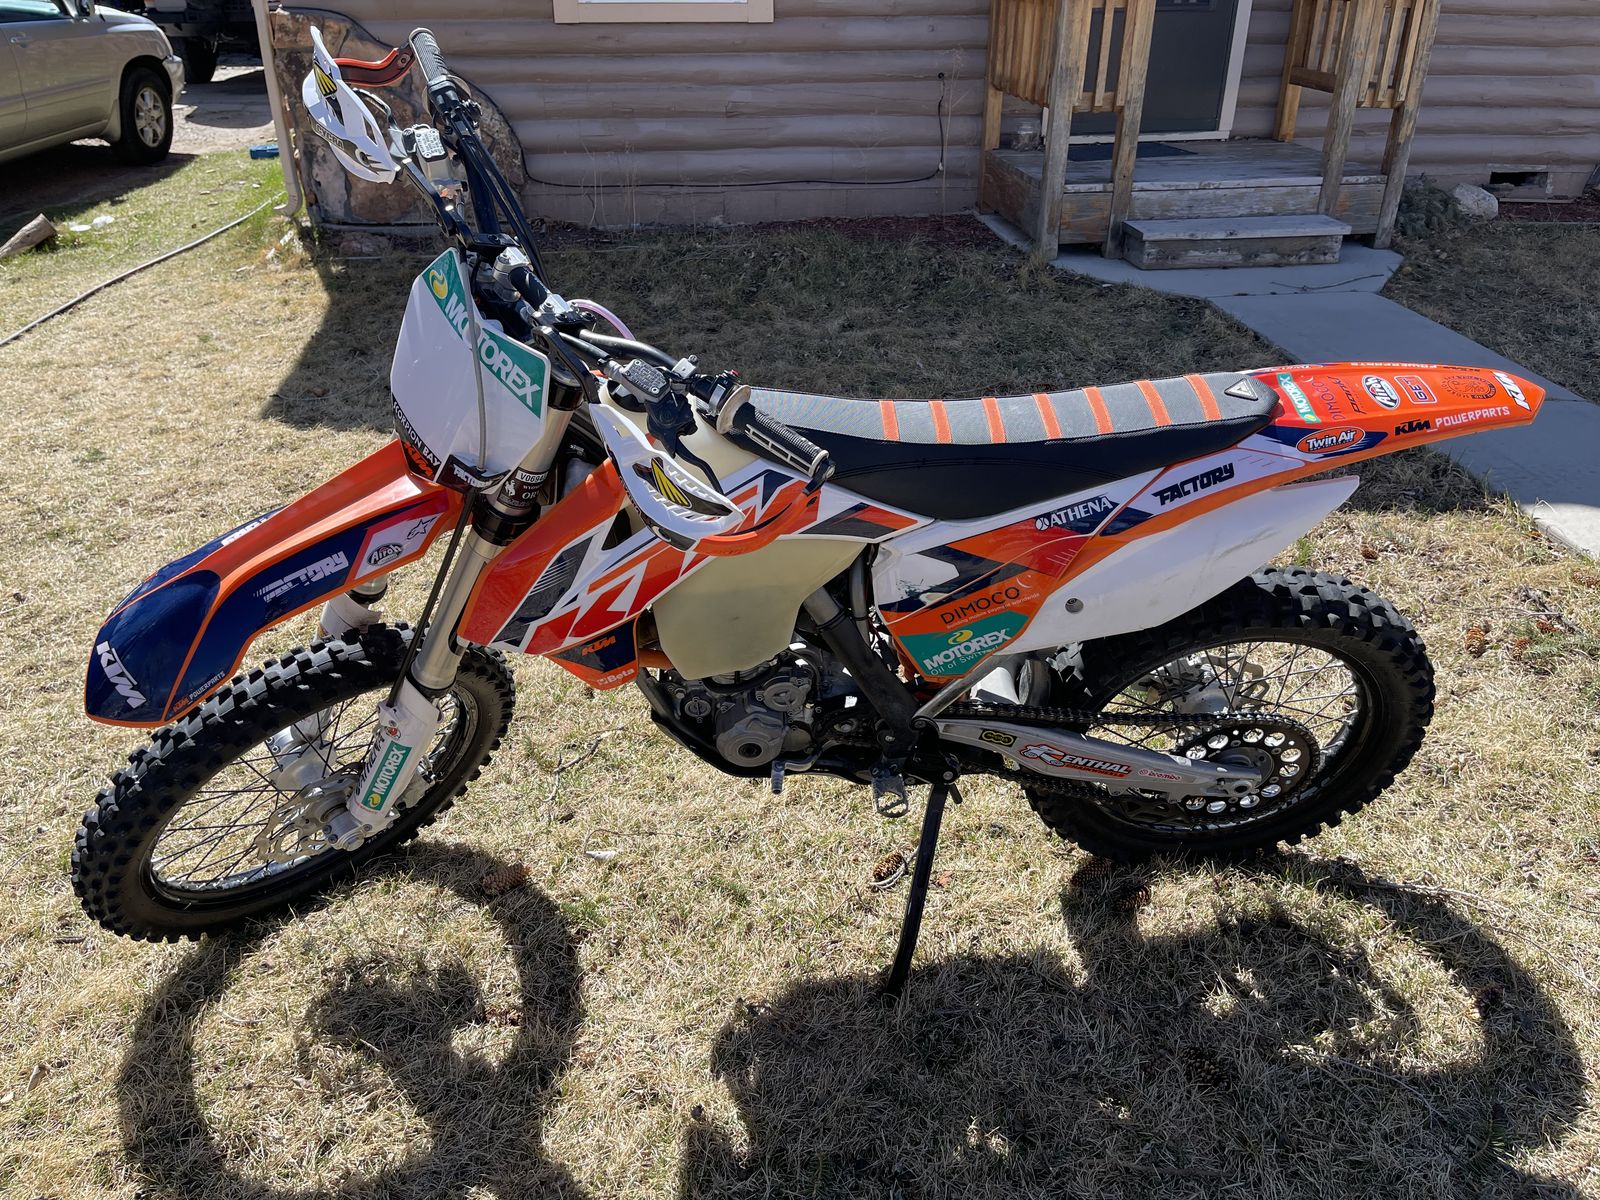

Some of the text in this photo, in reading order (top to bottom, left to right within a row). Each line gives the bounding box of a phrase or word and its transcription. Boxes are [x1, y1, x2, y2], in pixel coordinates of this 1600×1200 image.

[445, 293, 541, 408] MOTOREX
[1280, 376, 1312, 413] MOTOREX
[1311, 381, 1346, 420] DIMOCO
[1367, 377, 1396, 408] Airoh
[393, 401, 441, 466] SCORPION BAY
[1307, 435, 1337, 450] Twin
[1338, 430, 1357, 442] Air
[1395, 419, 1432, 436] KTM
[1151, 462, 1235, 506] FACTORY
[1049, 495, 1114, 527] ATHENA
[371, 544, 402, 564] Airoh
[940, 587, 1020, 624] DIMOCO
[581, 635, 617, 656] KTM
[923, 629, 1013, 670] MOTOREX
[96, 640, 147, 709] KTM
[930, 665, 945, 676] Oil
[947, 661, 957, 669] of
[372, 746, 406, 795] MOTOREX
[1020, 743, 1131, 774] RENTHAL
